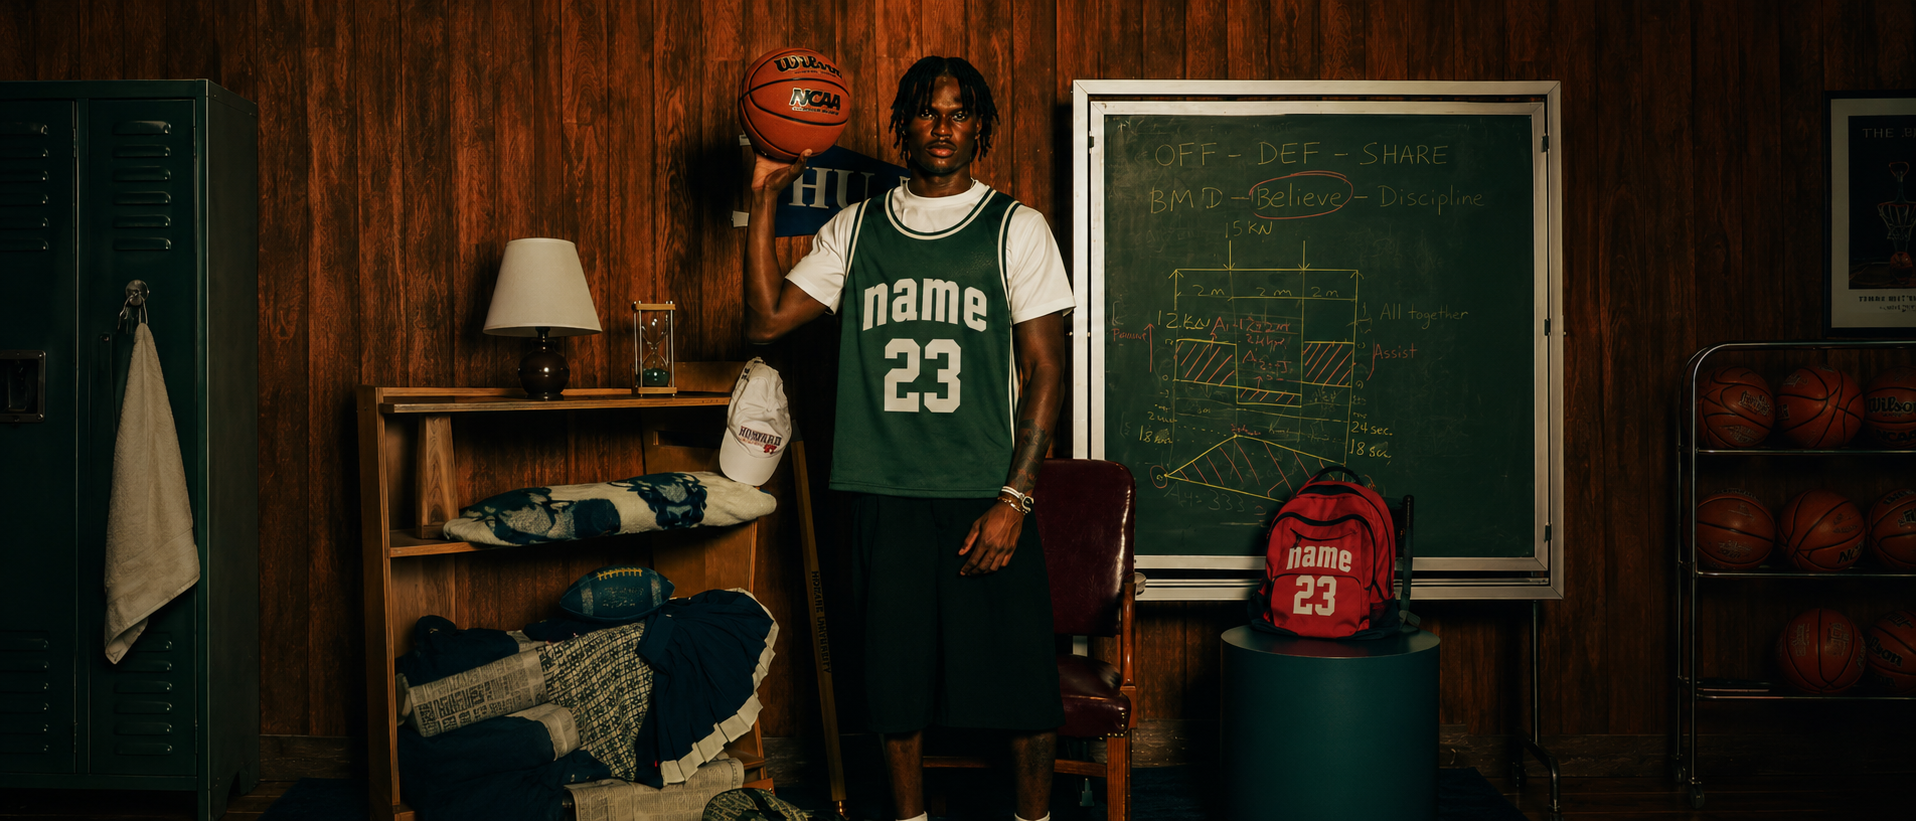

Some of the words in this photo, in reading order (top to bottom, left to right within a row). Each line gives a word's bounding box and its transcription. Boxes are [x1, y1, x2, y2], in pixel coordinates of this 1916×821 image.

[789, 88, 841, 110] NCAA
[1861, 127, 1895, 139] THE
[1155, 142, 1217, 166] OFF
[1257, 141, 1320, 165] DEF
[1359, 142, 1449, 165] SHARE
[1256, 182, 1342, 211] Believe
[1377, 184, 1485, 215] Discipline
[862, 278, 988, 332] name
[1380, 303, 1402, 320] All
[1408, 303, 1469, 330] together
[1375, 343, 1418, 359] Assist
[884, 338, 961, 413] 23
[1868, 396, 1916, 413] Wilso
[1350, 420, 1368, 434] 24
[1349, 438, 1366, 456] 18
[1286, 545, 1352, 573] name
[1292, 575, 1337, 616] 23
